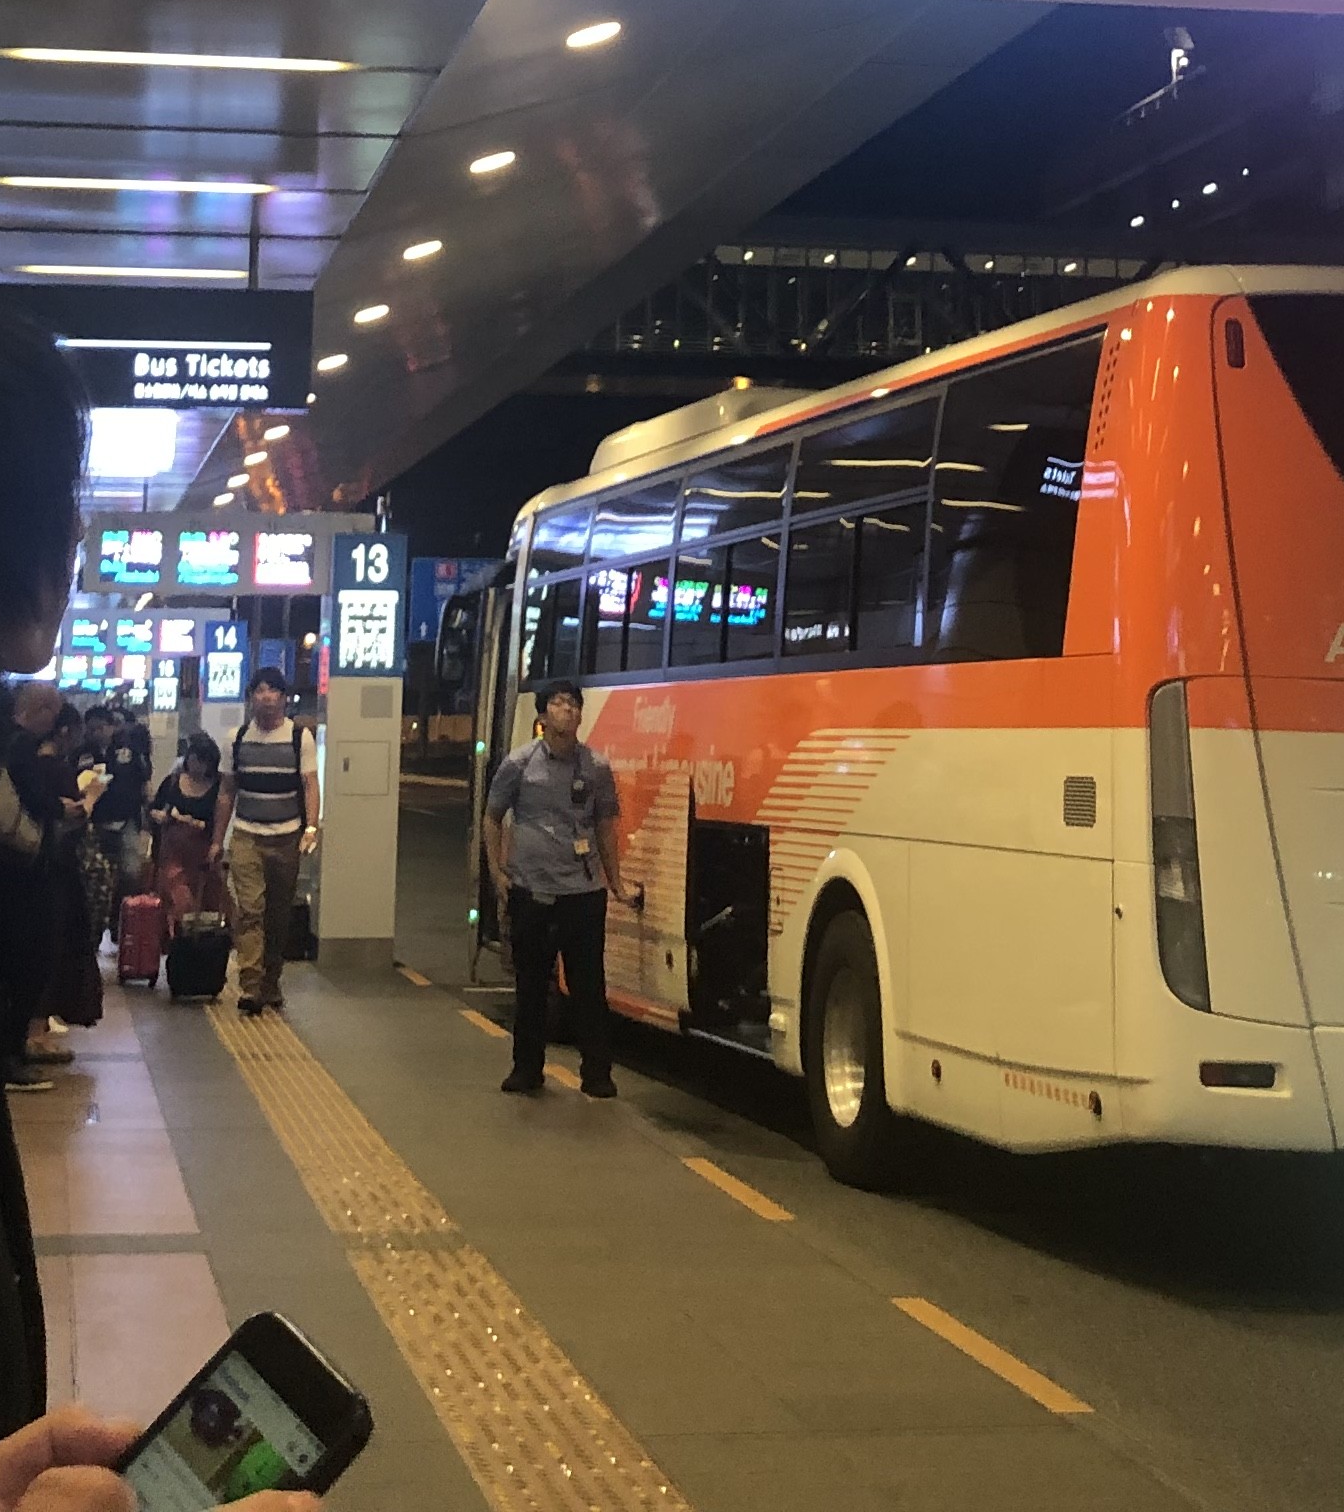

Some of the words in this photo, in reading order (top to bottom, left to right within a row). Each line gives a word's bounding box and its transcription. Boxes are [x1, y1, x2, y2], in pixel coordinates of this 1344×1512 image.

[134, 353, 178, 377] Bus
[185, 352, 271, 379] Tickets
[351, 542, 390, 584] 13
[214, 624, 238, 650] 14
